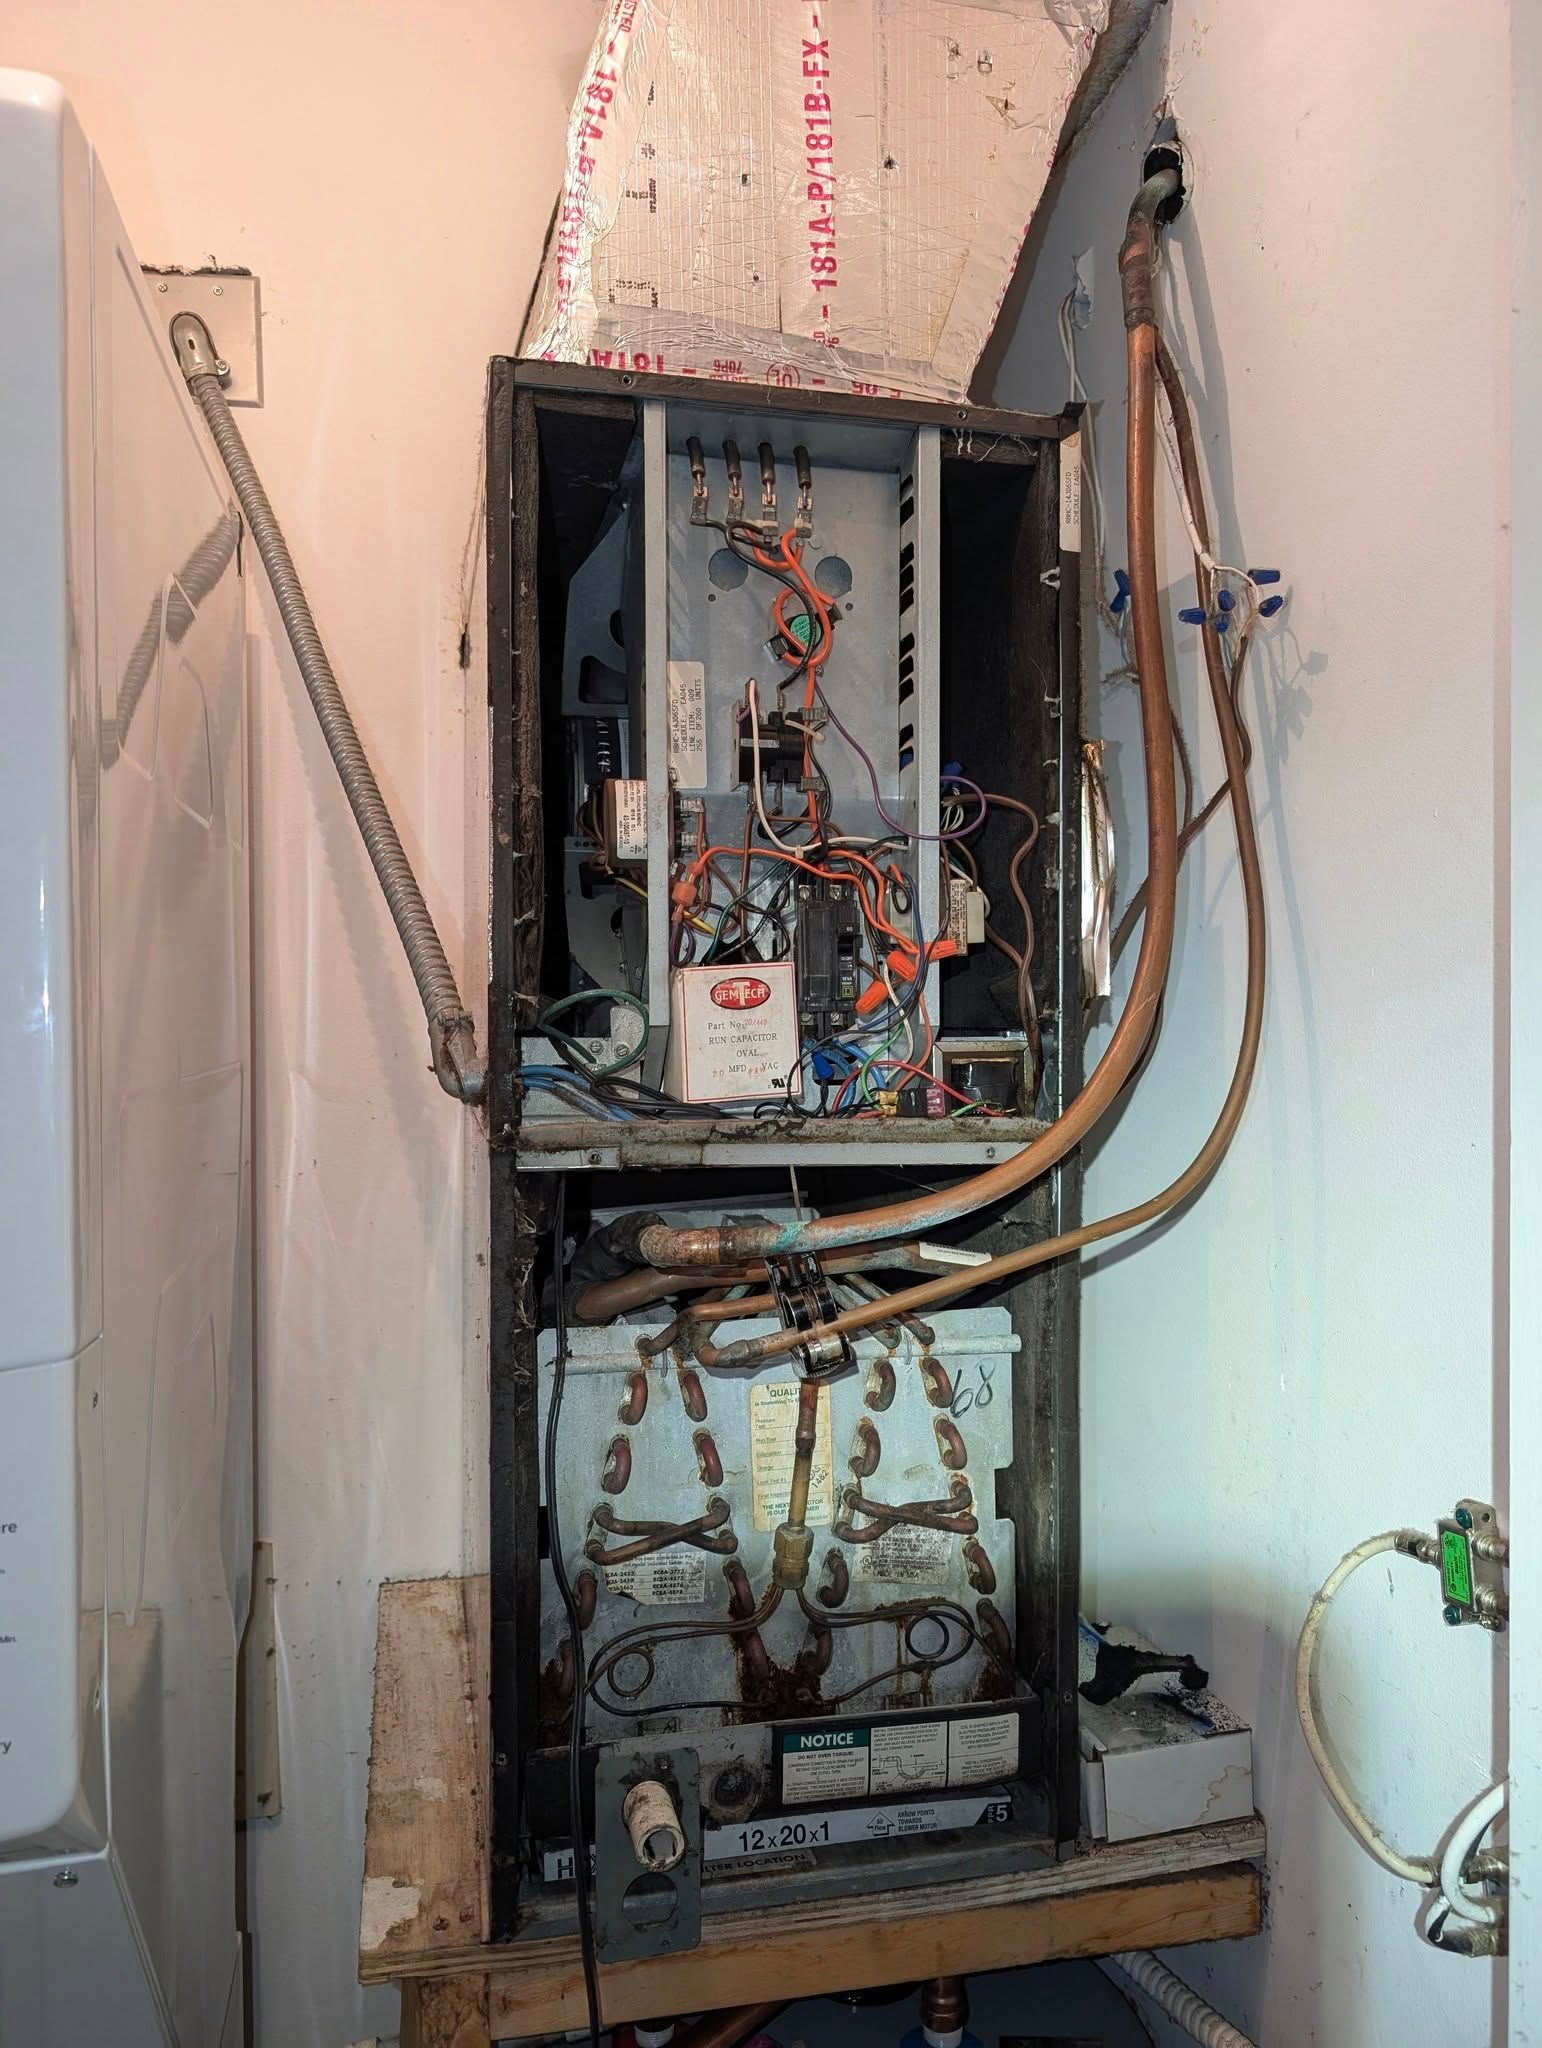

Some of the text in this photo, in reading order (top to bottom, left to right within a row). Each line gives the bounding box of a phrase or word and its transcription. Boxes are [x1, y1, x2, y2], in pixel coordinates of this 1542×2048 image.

[801, 39, 838, 291] 181A-P/181B-FX
[708, 1022, 725, 1030] Part
[709, 1033, 778, 1045] RUN CAPACITOR
[762, 1062, 779, 1070] VAC
[950, 1365, 995, 1418] 68
[800, 1732, 854, 1748] NOTICE
[916, 1809, 935, 1817] POINTS
[996, 1804, 1008, 1822] 5
[898, 1824, 919, 1832] BLOWER
[738, 1854, 805, 1868] LOCATION
